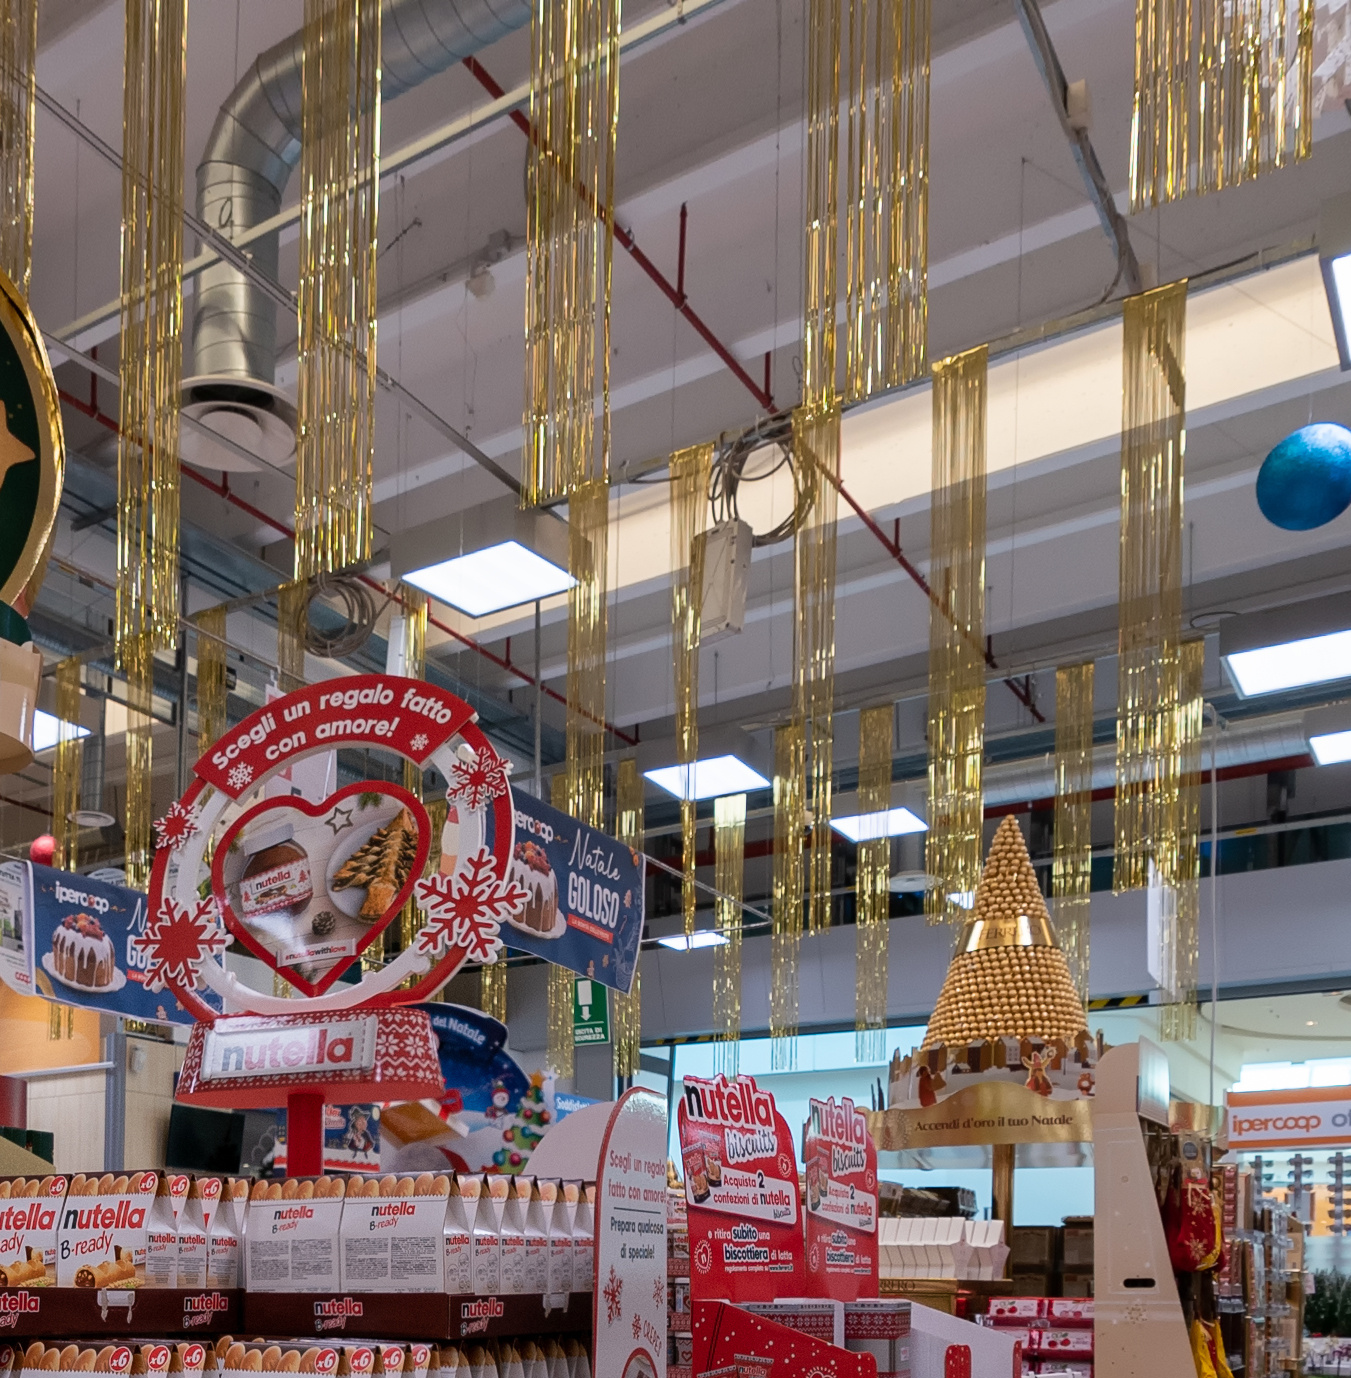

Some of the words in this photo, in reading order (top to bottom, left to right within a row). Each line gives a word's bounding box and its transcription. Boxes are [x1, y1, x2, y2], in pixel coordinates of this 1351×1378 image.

[212, 713, 276, 770] Scegli
[284, 700, 310, 724] un
[320, 684, 393, 711] regalo
[401, 688, 452, 725] fatto
[266, 732, 307, 761] con
[315, 717, 400, 739] amore!
[568, 828, 620, 880] Natale
[255, 869, 292, 893] nutella
[55, 880, 109, 914] ipercoop
[567, 871, 620, 928] GOLOSO
[449, 1020, 486, 1046] Natale
[222, 1029, 353, 1071] nutella
[684, 1083, 774, 1129] nutella
[811, 1104, 865, 1148] nutella
[915, 1118, 961, 1131] Accendi
[963, 1117, 988, 1129] d'oro
[993, 1117, 1004, 1127] il
[1007, 1117, 1029, 1126] tuo
[1031, 1114, 1073, 1126] Natale
[1231, 1113, 1321, 1135] ipercoop
[726, 1129, 776, 1160] biscuits
[610, 1150, 632, 1173] Scegli
[634, 1158, 642, 1172] un
[644, 1159, 665, 1178] regalo
[832, 1147, 865, 1175] biscuits
[51, 1178, 64, 1194] x6
[609, 1179, 625, 1198] fatto
[629, 1186, 641, 1200] con
[723, 1174, 756, 1188] Acquista
[758, 1172, 765, 1188] 2
[713, 1193, 749, 1205] confezioni
[752, 1194, 758, 1205] di
[760, 1193, 790, 1206] nutella
[610, 1216, 636, 1237] Prepara
[638, 1219, 664, 1236] qualcosa
[714, 1229, 731, 1239] ritira
[733, 1224, 758, 1240] subito
[759, 1232, 770, 1241] una
[621, 1243, 626, 1259] di
[628, 1244, 655, 1262] speciale!
[724, 1246, 769, 1261] biscottiera
[771, 1251, 777, 1260] di
[778, 1249, 793, 1260] latta
